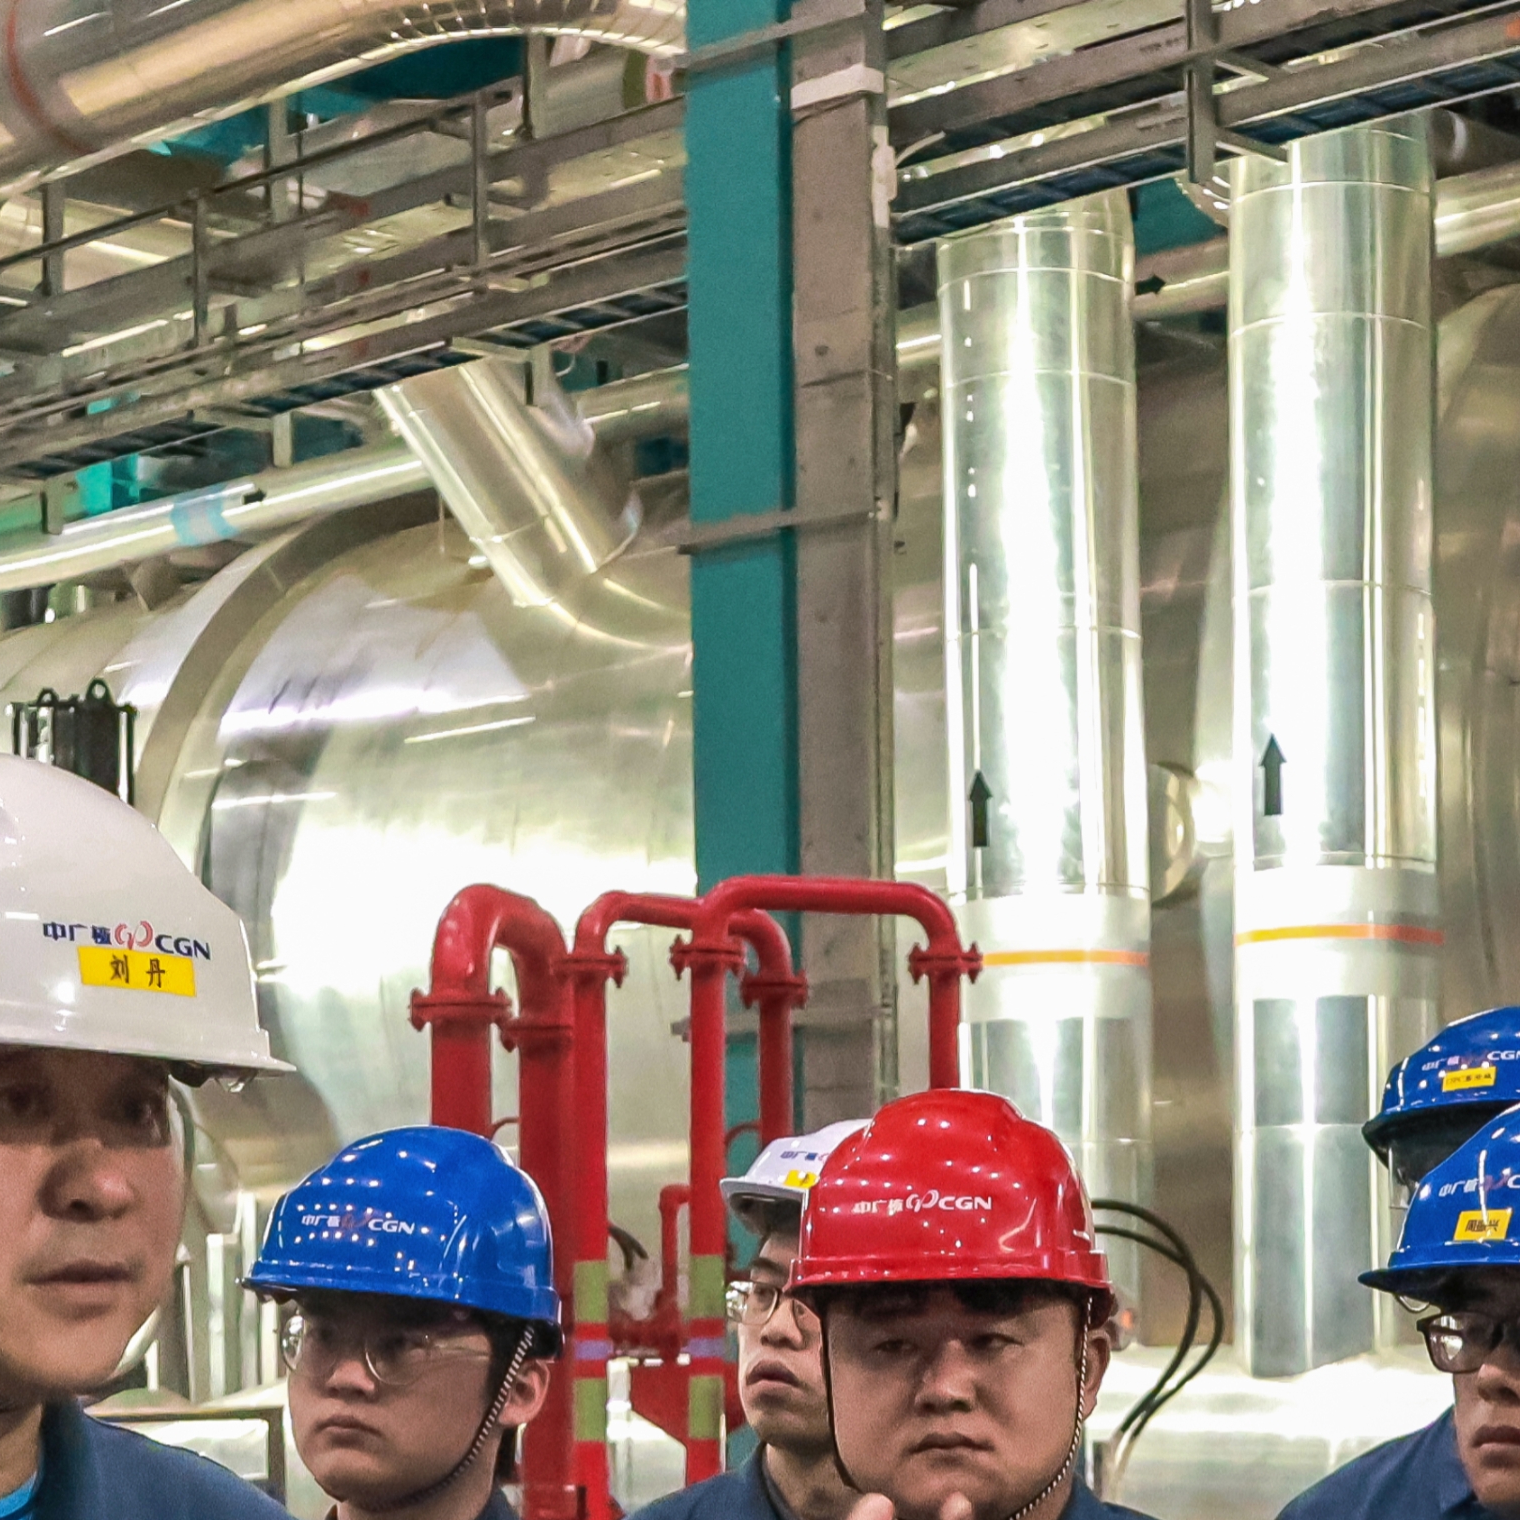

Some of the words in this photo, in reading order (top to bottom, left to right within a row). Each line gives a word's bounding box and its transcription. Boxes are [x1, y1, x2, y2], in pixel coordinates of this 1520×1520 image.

[155, 934, 211, 960] CGN
[938, 1196, 992, 1210] CGN
[368, 1218, 415, 1235] CGN
